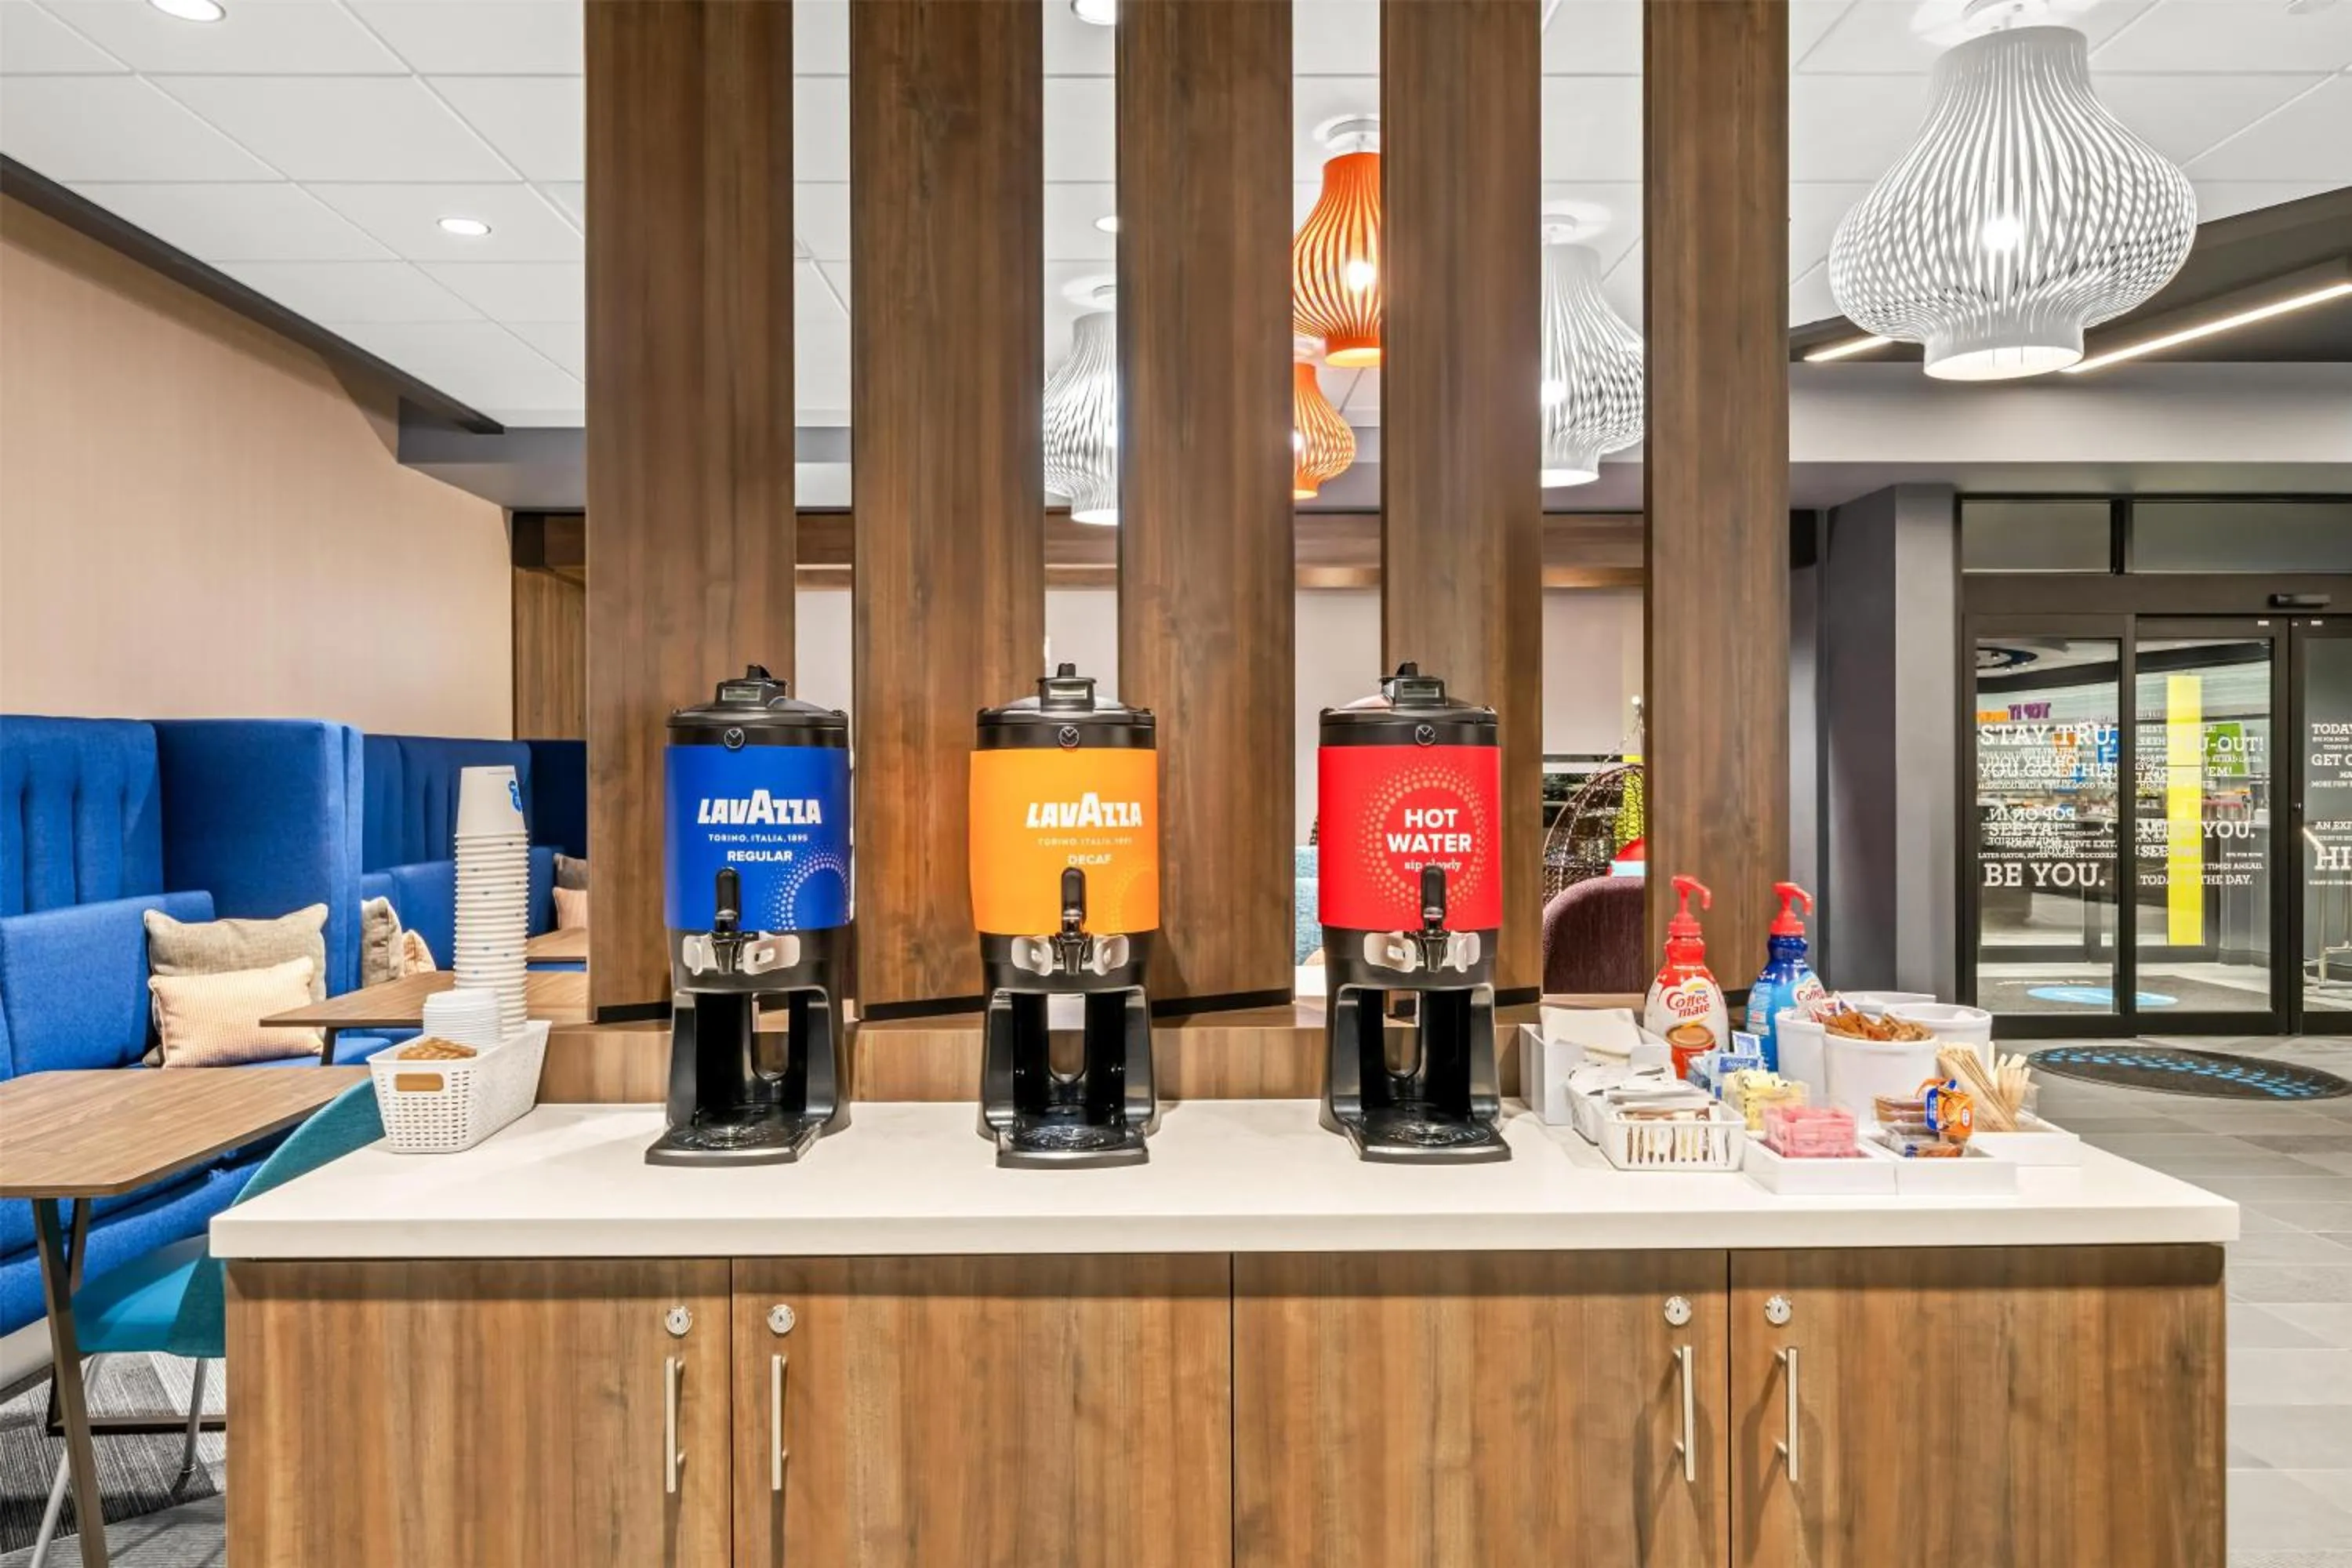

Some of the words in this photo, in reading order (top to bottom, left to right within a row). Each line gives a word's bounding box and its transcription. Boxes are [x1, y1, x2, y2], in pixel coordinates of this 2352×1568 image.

[1980, 724, 2050, 746] STAY
[2311, 753, 2343, 766] GET
[697, 789, 822, 825] LAVAZZA
[1025, 792, 1143, 828] LAVAZZA
[1404, 808, 1458, 829] HOT
[2202, 821, 2256, 839] YOU.
[1386, 833, 1472, 853] WATER
[727, 850, 793, 862] REGULAR
[1067, 854, 1112, 865] DECAF
[1984, 862, 2023, 887] BE
[2030, 862, 2106, 887] YOU.
[1666, 991, 1708, 1011] Coffee
[1679, 1004, 1710, 1018] mate
